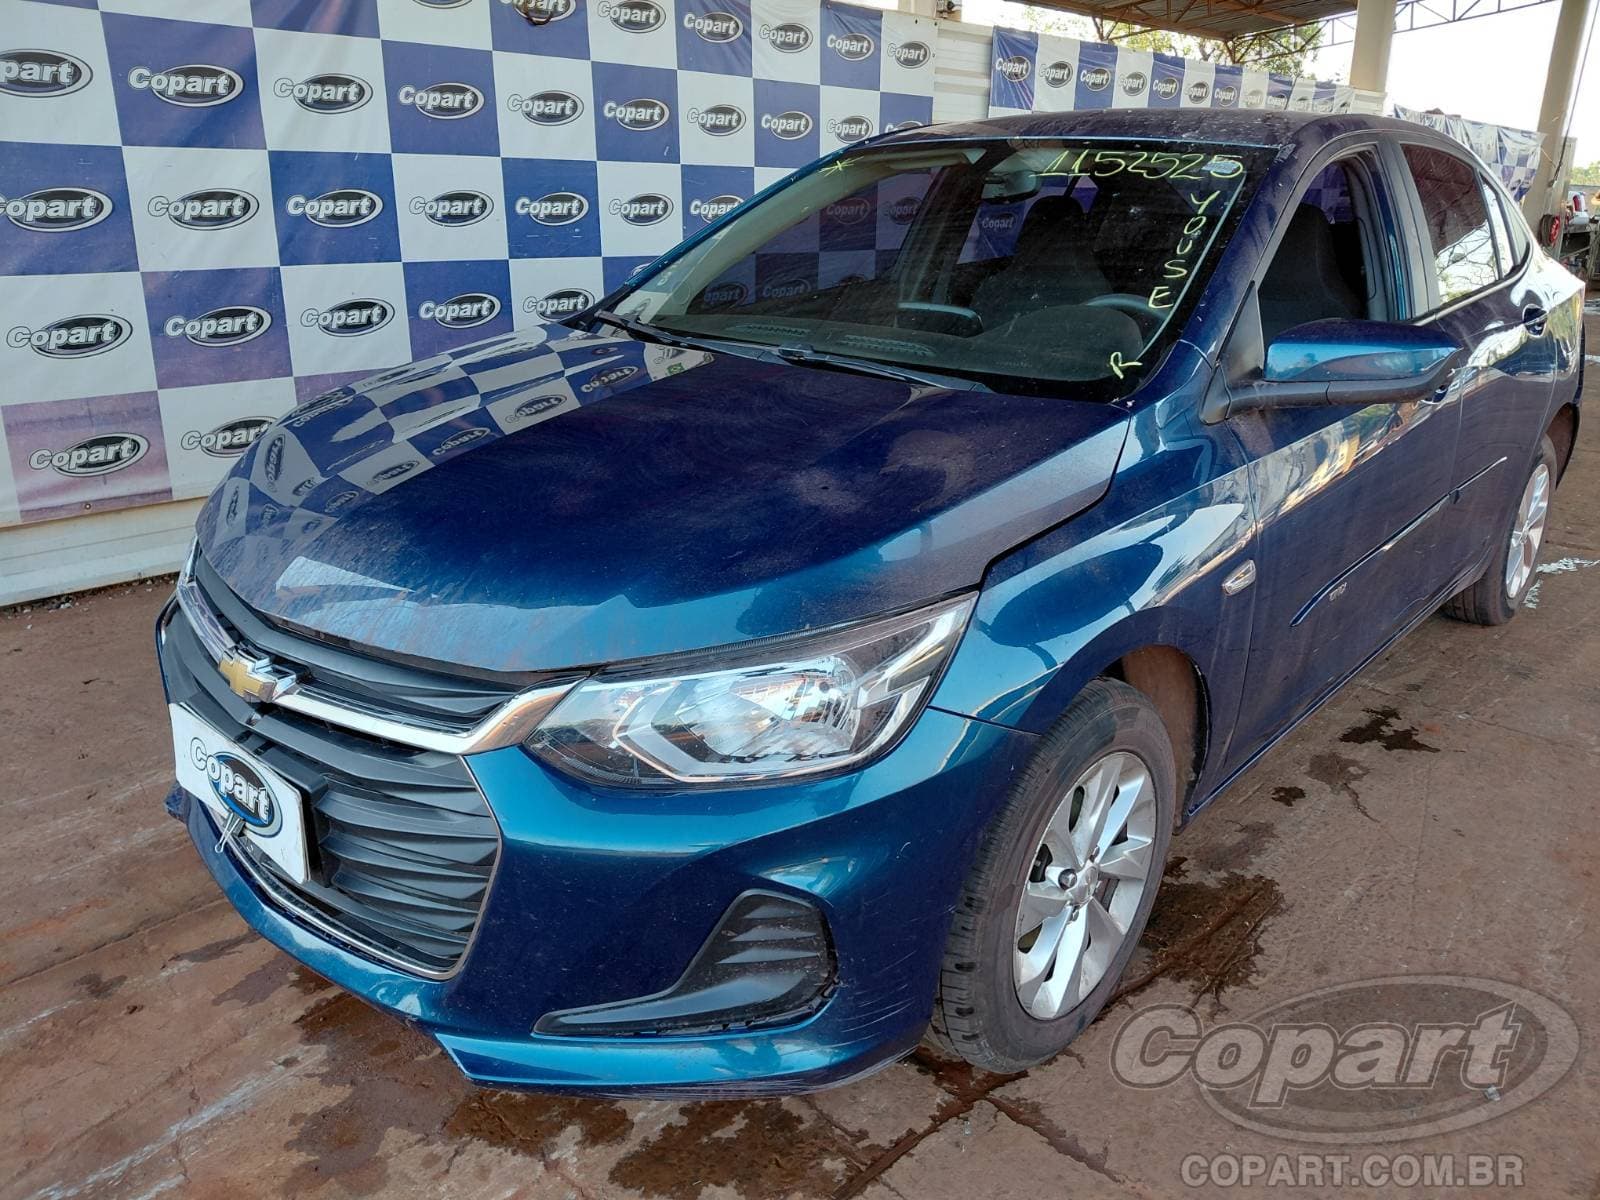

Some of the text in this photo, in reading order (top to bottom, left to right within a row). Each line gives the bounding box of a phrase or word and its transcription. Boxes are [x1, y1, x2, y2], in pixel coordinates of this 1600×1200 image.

[598, 1, 657, 23] Copart
[684, 13, 736, 35] Copart
[760, 23, 806, 45] Copart
[826, 34, 868, 54] Copart
[887, 42, 925, 61] Copart
[0, 60, 72, 84] part
[996, 58, 1026, 75] Copart
[1039, 64, 1068, 81] Copart
[1080, 69, 1109, 85] Copart
[128, 66, 229, 95] Copart
[274, 77, 360, 103] Copart
[1152, 79, 1176, 96] Copart
[400, 85, 473, 109] Copart
[507, 94, 574, 116] Copart
[604, 102, 661, 122] Copart
[687, 108, 739, 129] Copart
[761, 113, 806, 134] Copart
[827, 119, 868, 138] Copart
[148, 195, 246, 221] Copart
[287, 195, 371, 219] Copart
[409, 196, 483, 219] Copart
[515, 196, 580, 219] Copart
[609, 199, 664, 217] Copart
[826, 203, 865, 216] Copart
[982, 217, 1014, 231] Copart
[419, 300, 492, 322] Copart
[523, 294, 586, 315] Copart
[164, 311, 258, 339] Copart
[300, 305, 383, 329] Copart
[6, 321, 115, 350] Copart
[29, 437, 134, 471] Copart
[190, 737, 270, 824] Copart
